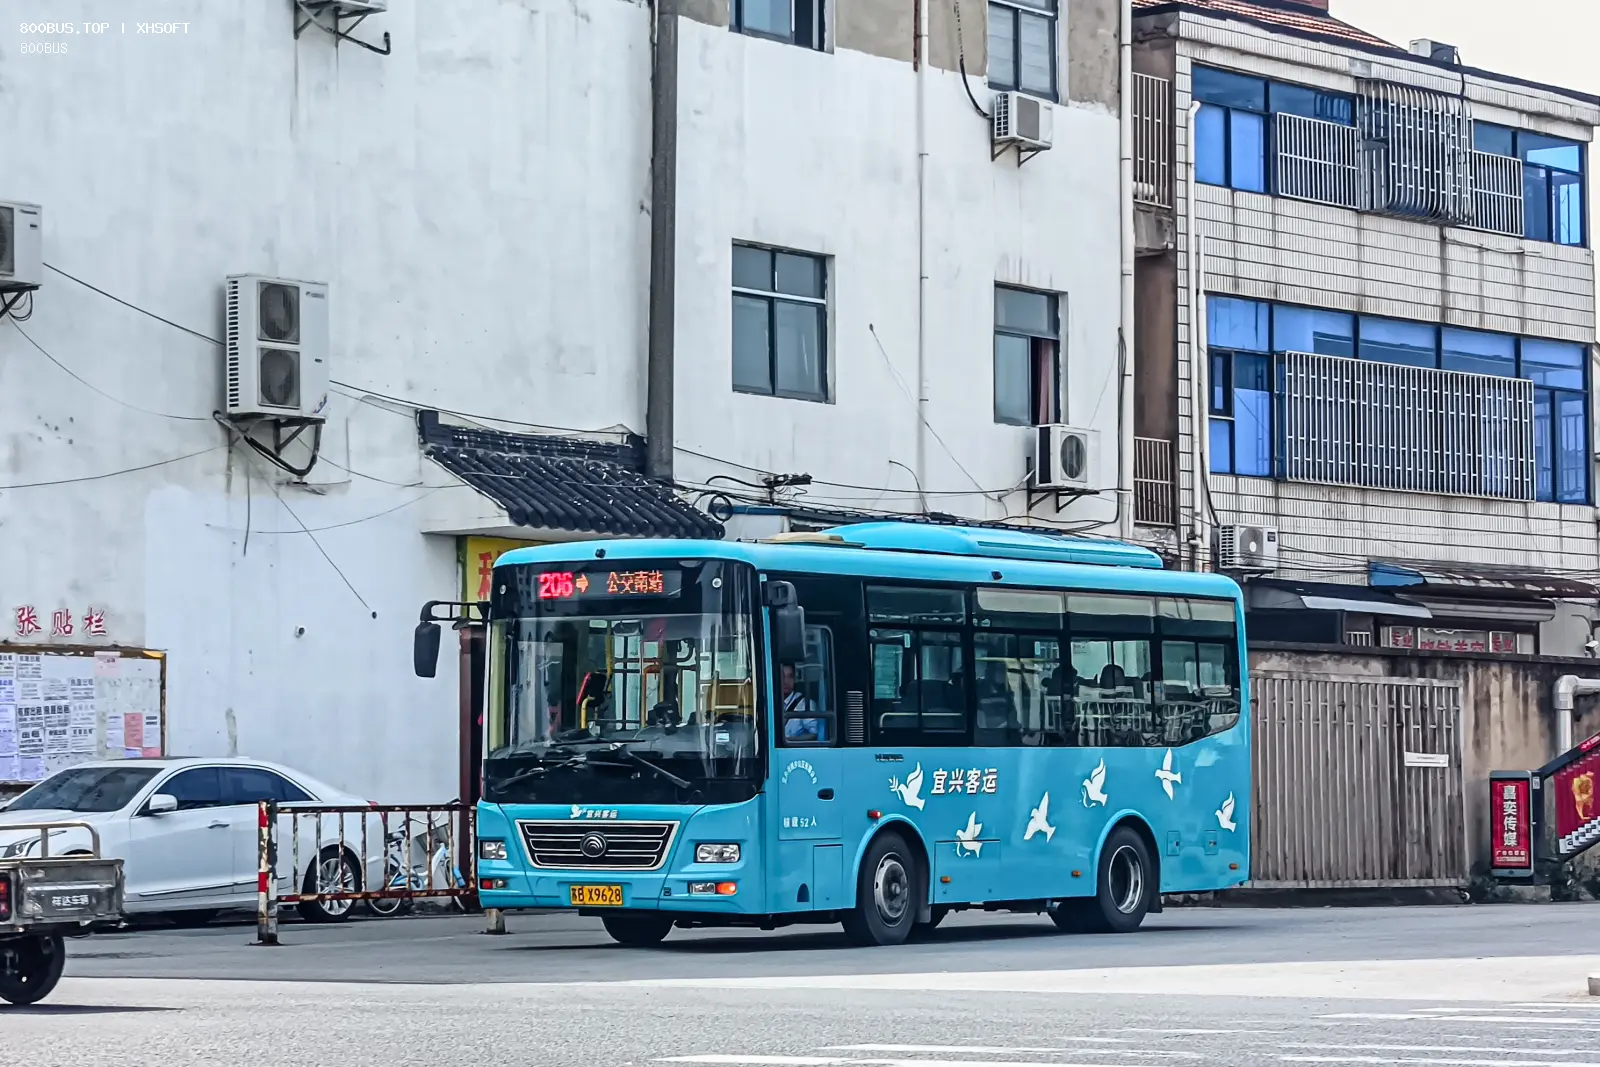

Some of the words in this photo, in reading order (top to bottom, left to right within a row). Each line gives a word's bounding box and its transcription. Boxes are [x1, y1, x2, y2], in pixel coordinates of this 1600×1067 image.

[539, 572, 574, 599] 206
[606, 570, 664, 594] 公交南站
[15, 606, 108, 637] 张贴栏
[930, 767, 999, 795] 宜兴客运
[585, 809, 618, 819] 宜兴客运
[587, 887, 622, 904] X9628
